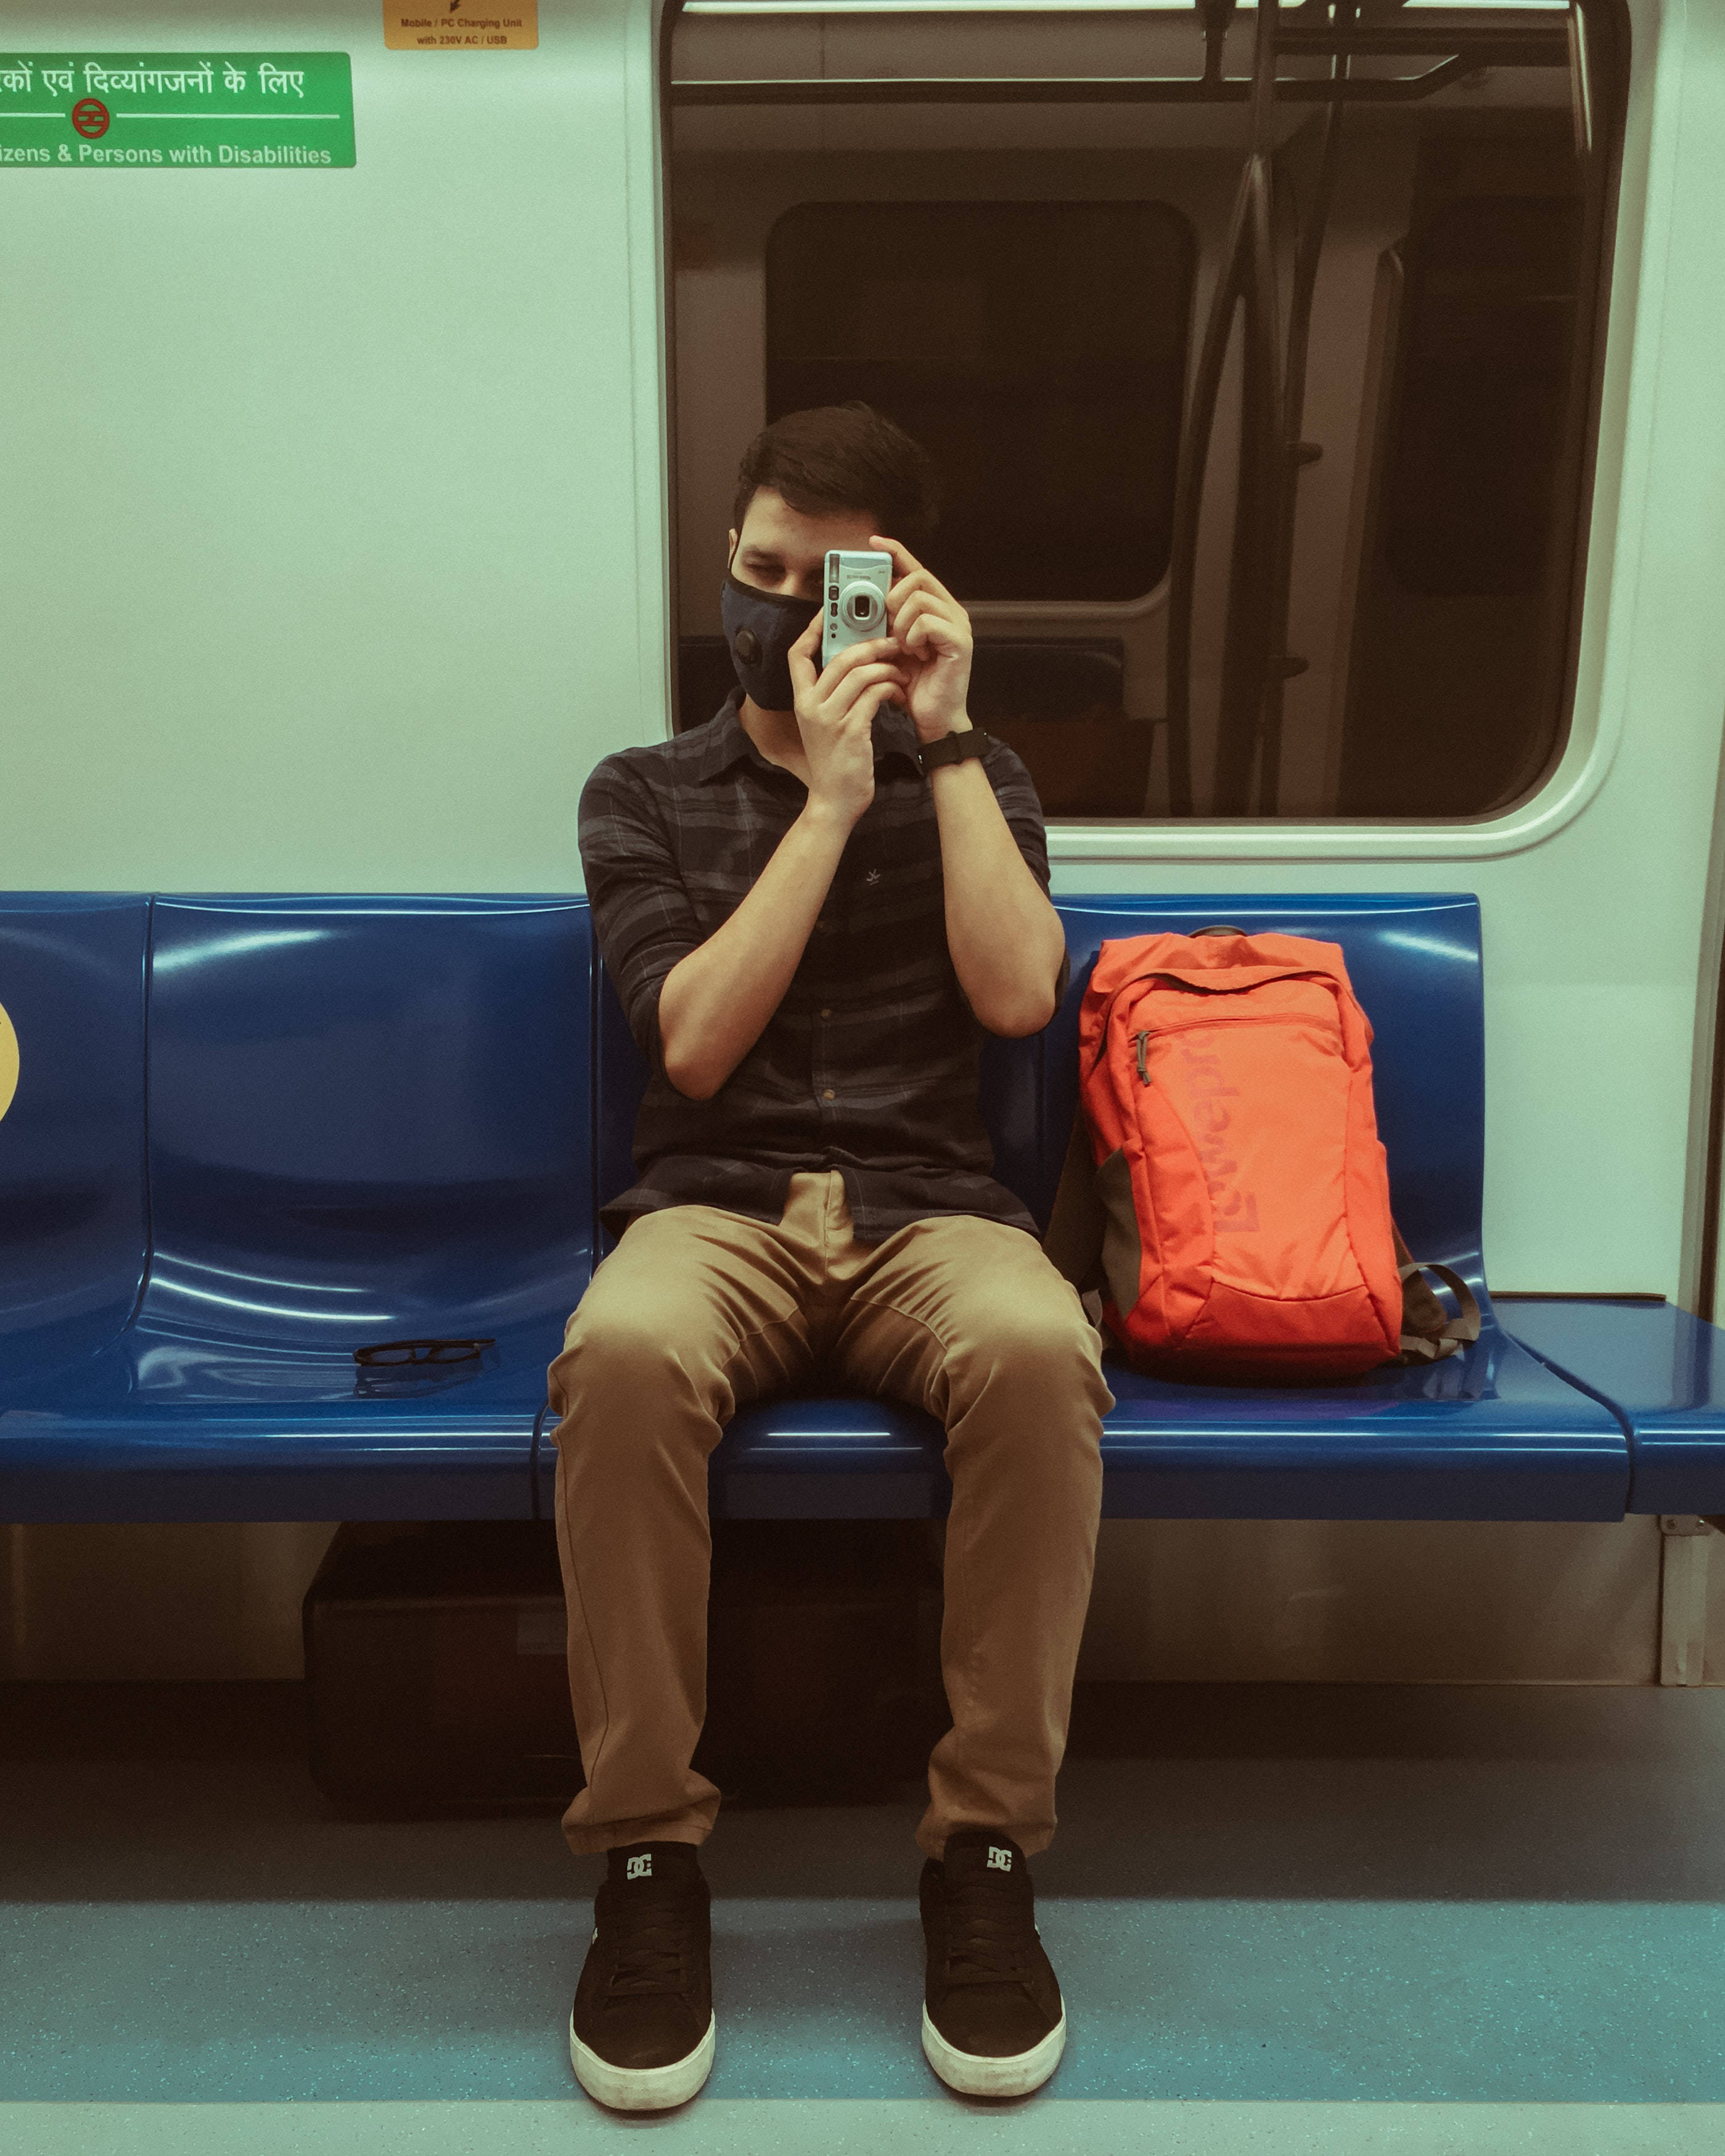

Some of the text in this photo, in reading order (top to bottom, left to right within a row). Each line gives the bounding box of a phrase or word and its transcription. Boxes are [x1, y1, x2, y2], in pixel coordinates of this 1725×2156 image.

[401, 18, 523, 30] Mobile / PC Charging Unit
[417, 36, 436, 44] with
[440, 36, 462, 44] 230V
[464, 36, 478, 44] AC
[486, 35, 507, 44] USB
[0, 60, 305, 98] कों एवं दिव्यांगजनों के लिए
[57, 144, 73, 162] &
[79, 144, 163, 163] Persons
[169, 145, 211, 163] with
[218, 145, 331, 164] Disabilities
[626, 1853, 652, 1880] DC
[986, 1846, 1012, 1872] DC
